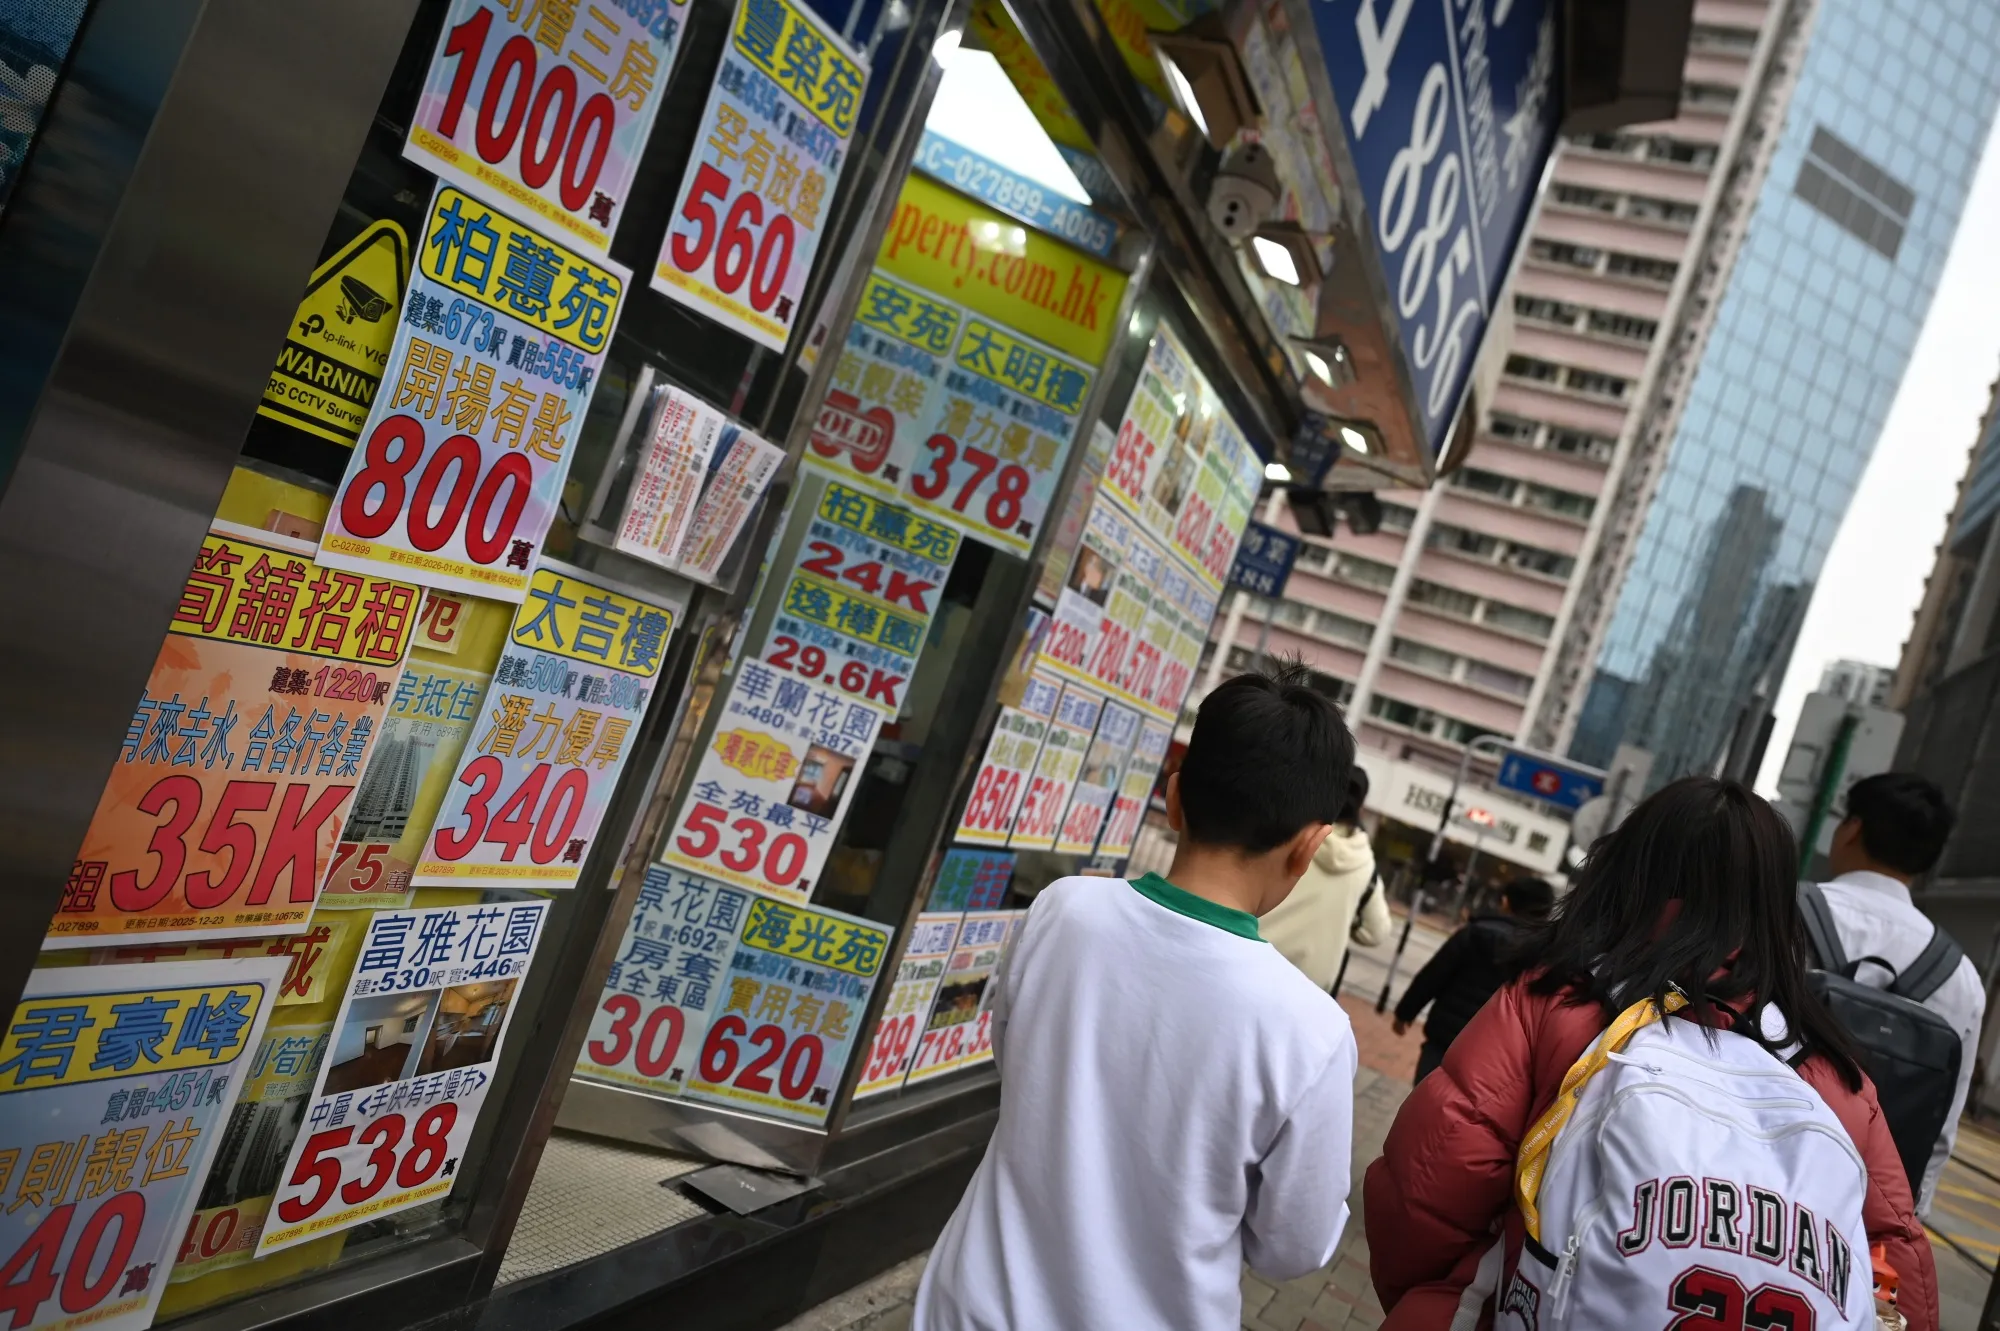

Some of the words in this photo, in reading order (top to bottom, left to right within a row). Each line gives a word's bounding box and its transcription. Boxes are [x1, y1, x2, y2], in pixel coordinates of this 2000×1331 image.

[432, 199, 617, 346] 柏蕙苑
[886, 201, 1108, 332] perty.com.hk
[276, 346, 375, 404] WARNIN
[322, 329, 357, 352] tp-link
[288, 387, 327, 410] CCTV
[326, 402, 366, 427] Surve
[390, 337, 573, 463] 開揚有匙
[331, 538, 371, 556] C-027899
[801, 541, 938, 615] 24K
[516, 579, 669, 673] 太吉樓
[735, 662, 878, 744] 華蘭花園
[766, 635, 906, 708] 29.6K
[477, 692, 633, 770] 潛力優厚
[694, 779, 831, 838] 全苑最平
[422, 865, 456, 875] C-027899
[123, 914, 226, 931] 更新日期:2025-12-23
[233, 910, 305, 926] 物業編號:106796
[358, 905, 546, 974] 富雅花園
[740, 901, 885, 976] 海光苑
[0, 990, 252, 1085] 君豪峰
[723, 974, 854, 1042] 實用有匙
[309, 1091, 355, 1132] 中層
[265, 1226, 304, 1246] C-027899
[1616, 1175, 1852, 1322] JORDAN
